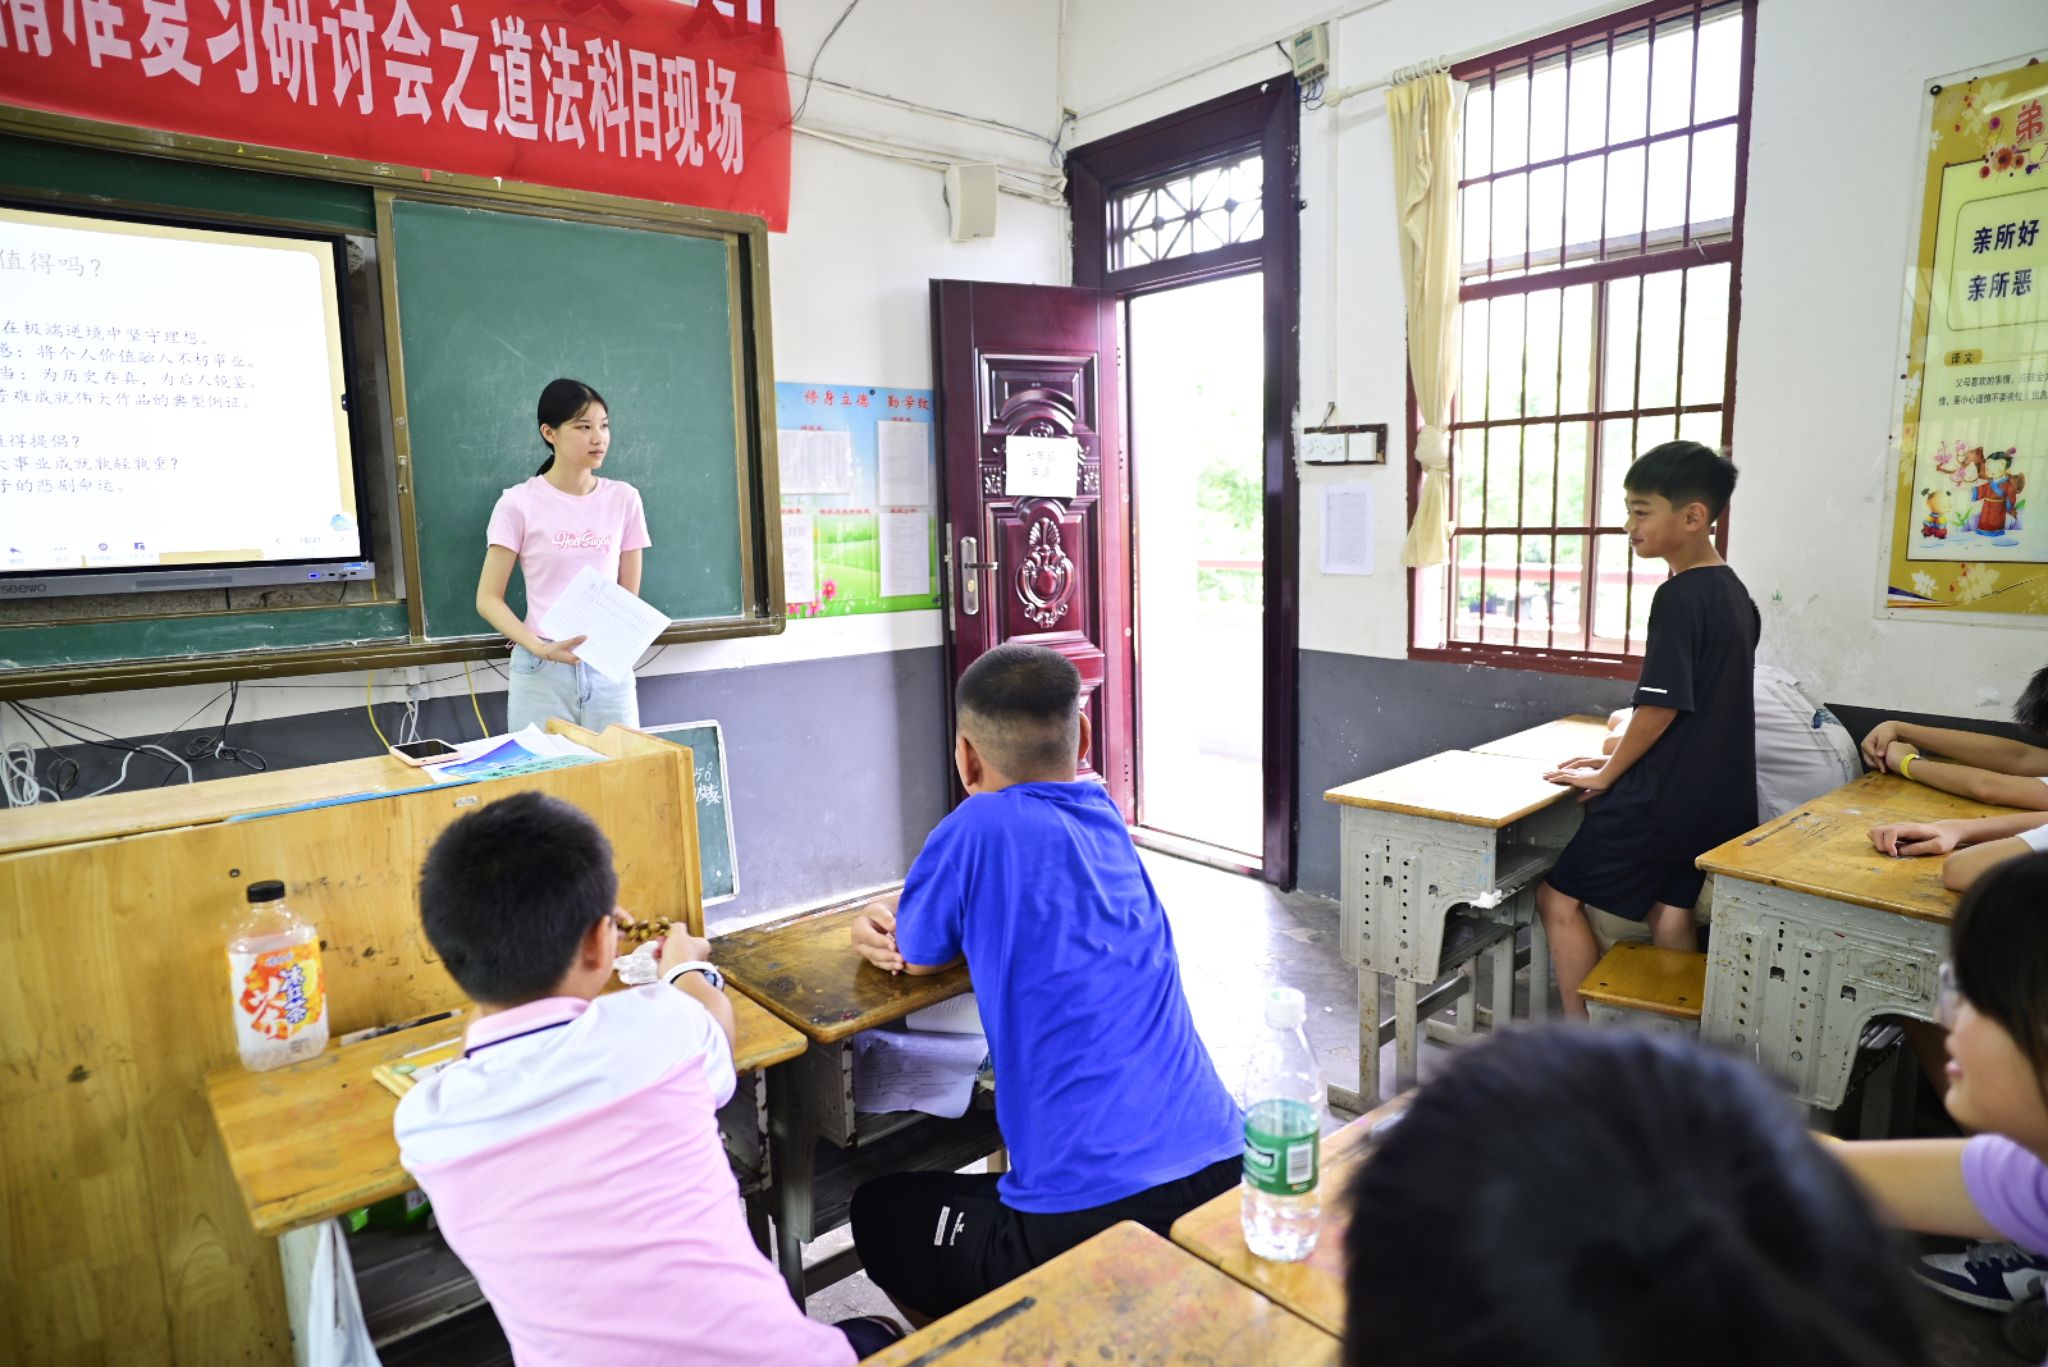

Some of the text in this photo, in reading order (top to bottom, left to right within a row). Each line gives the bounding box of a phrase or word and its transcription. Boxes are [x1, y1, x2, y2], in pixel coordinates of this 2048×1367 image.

[2016, 98, 2043, 145] 弟
[1972, 219, 2040, 254] 亲所好
[1967, 268, 2033, 302] 亲所恶
[1950, 352, 1974, 366] 译文
[804, 390, 870, 408] 修身立德
[0, 583, 47, 594] seewo
